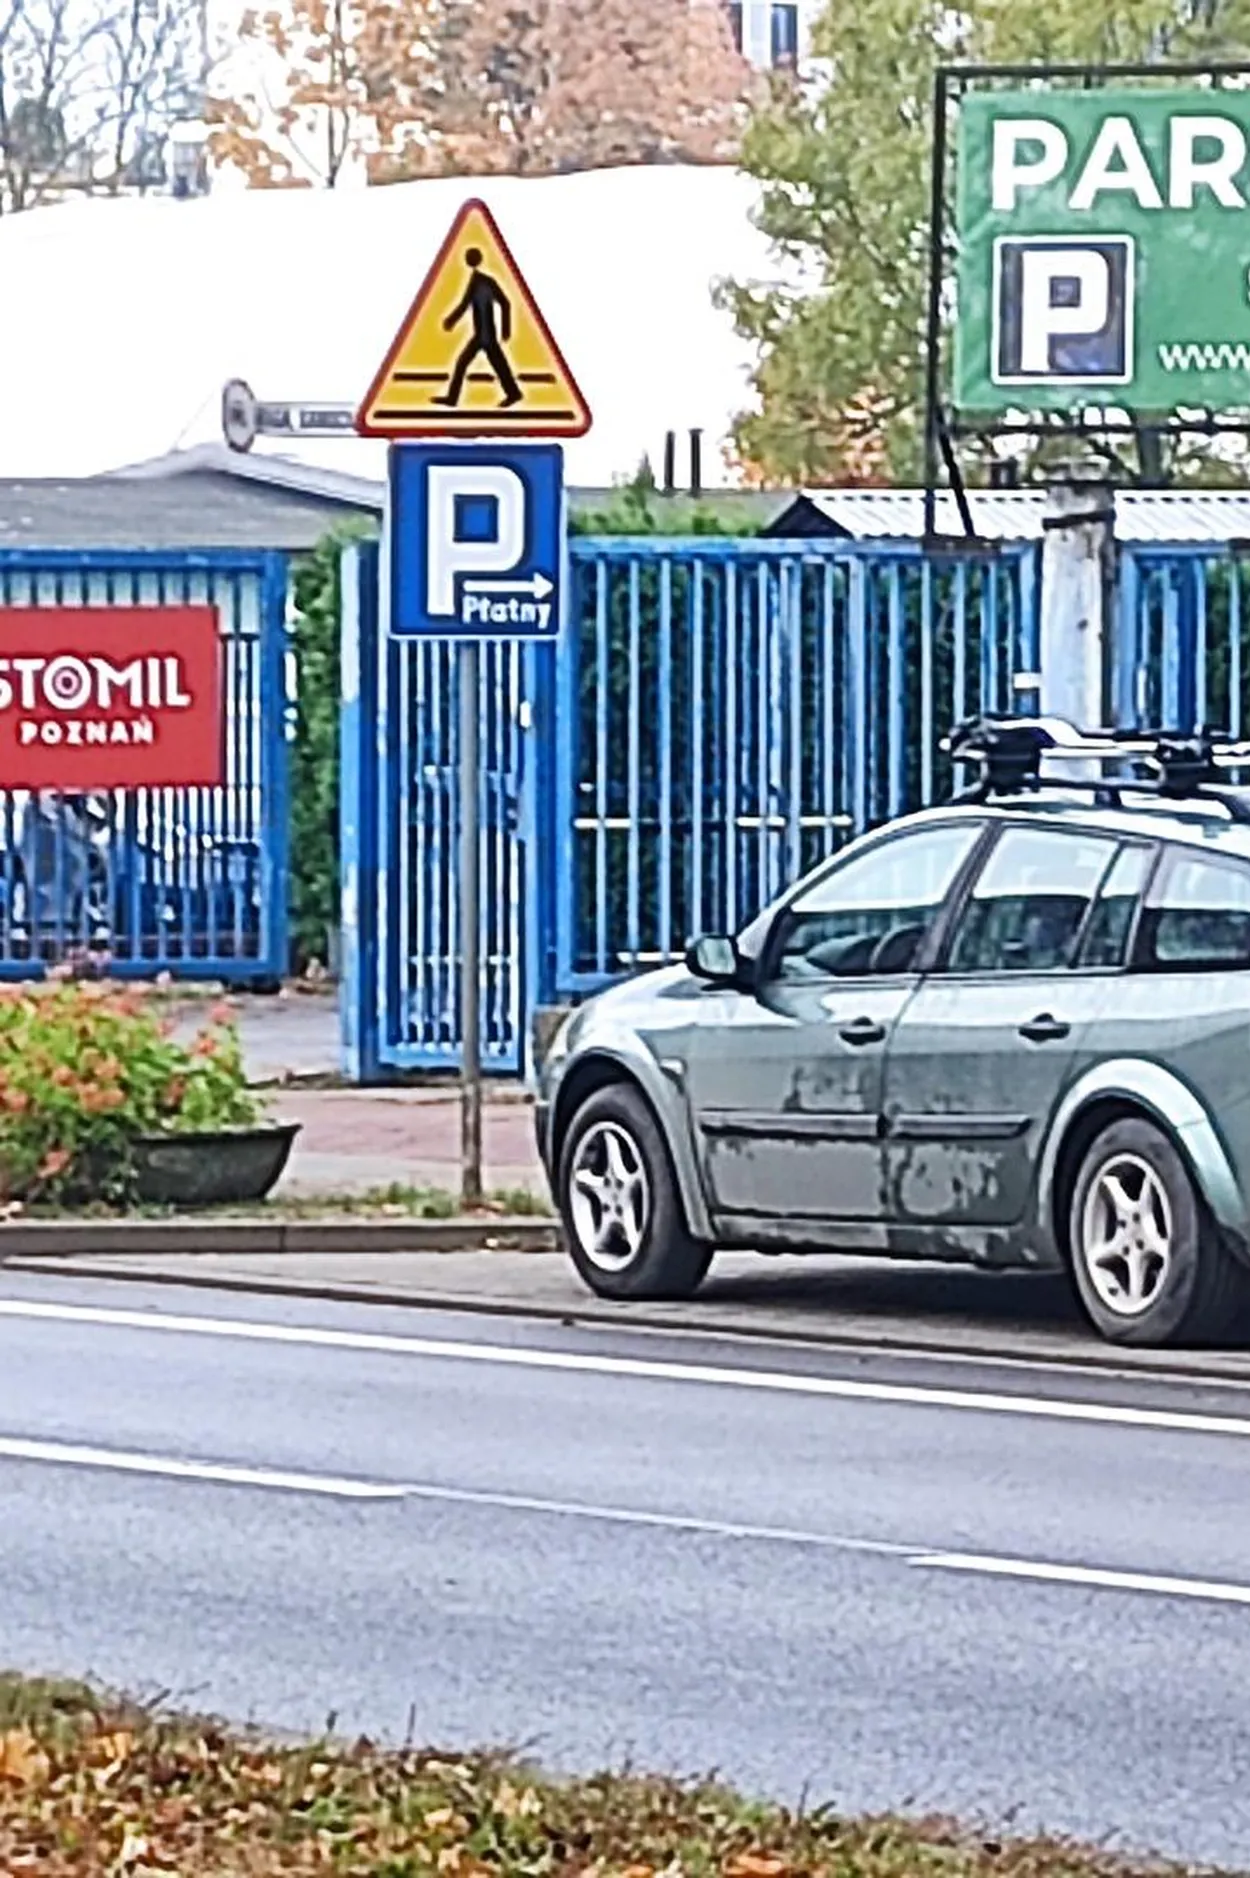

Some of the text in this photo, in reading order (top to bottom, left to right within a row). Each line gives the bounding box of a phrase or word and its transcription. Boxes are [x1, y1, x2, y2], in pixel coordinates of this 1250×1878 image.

[1020, 249, 1110, 373] P
[427, 465, 525, 615] P
[19, 713, 154, 745] POZNAŃ
